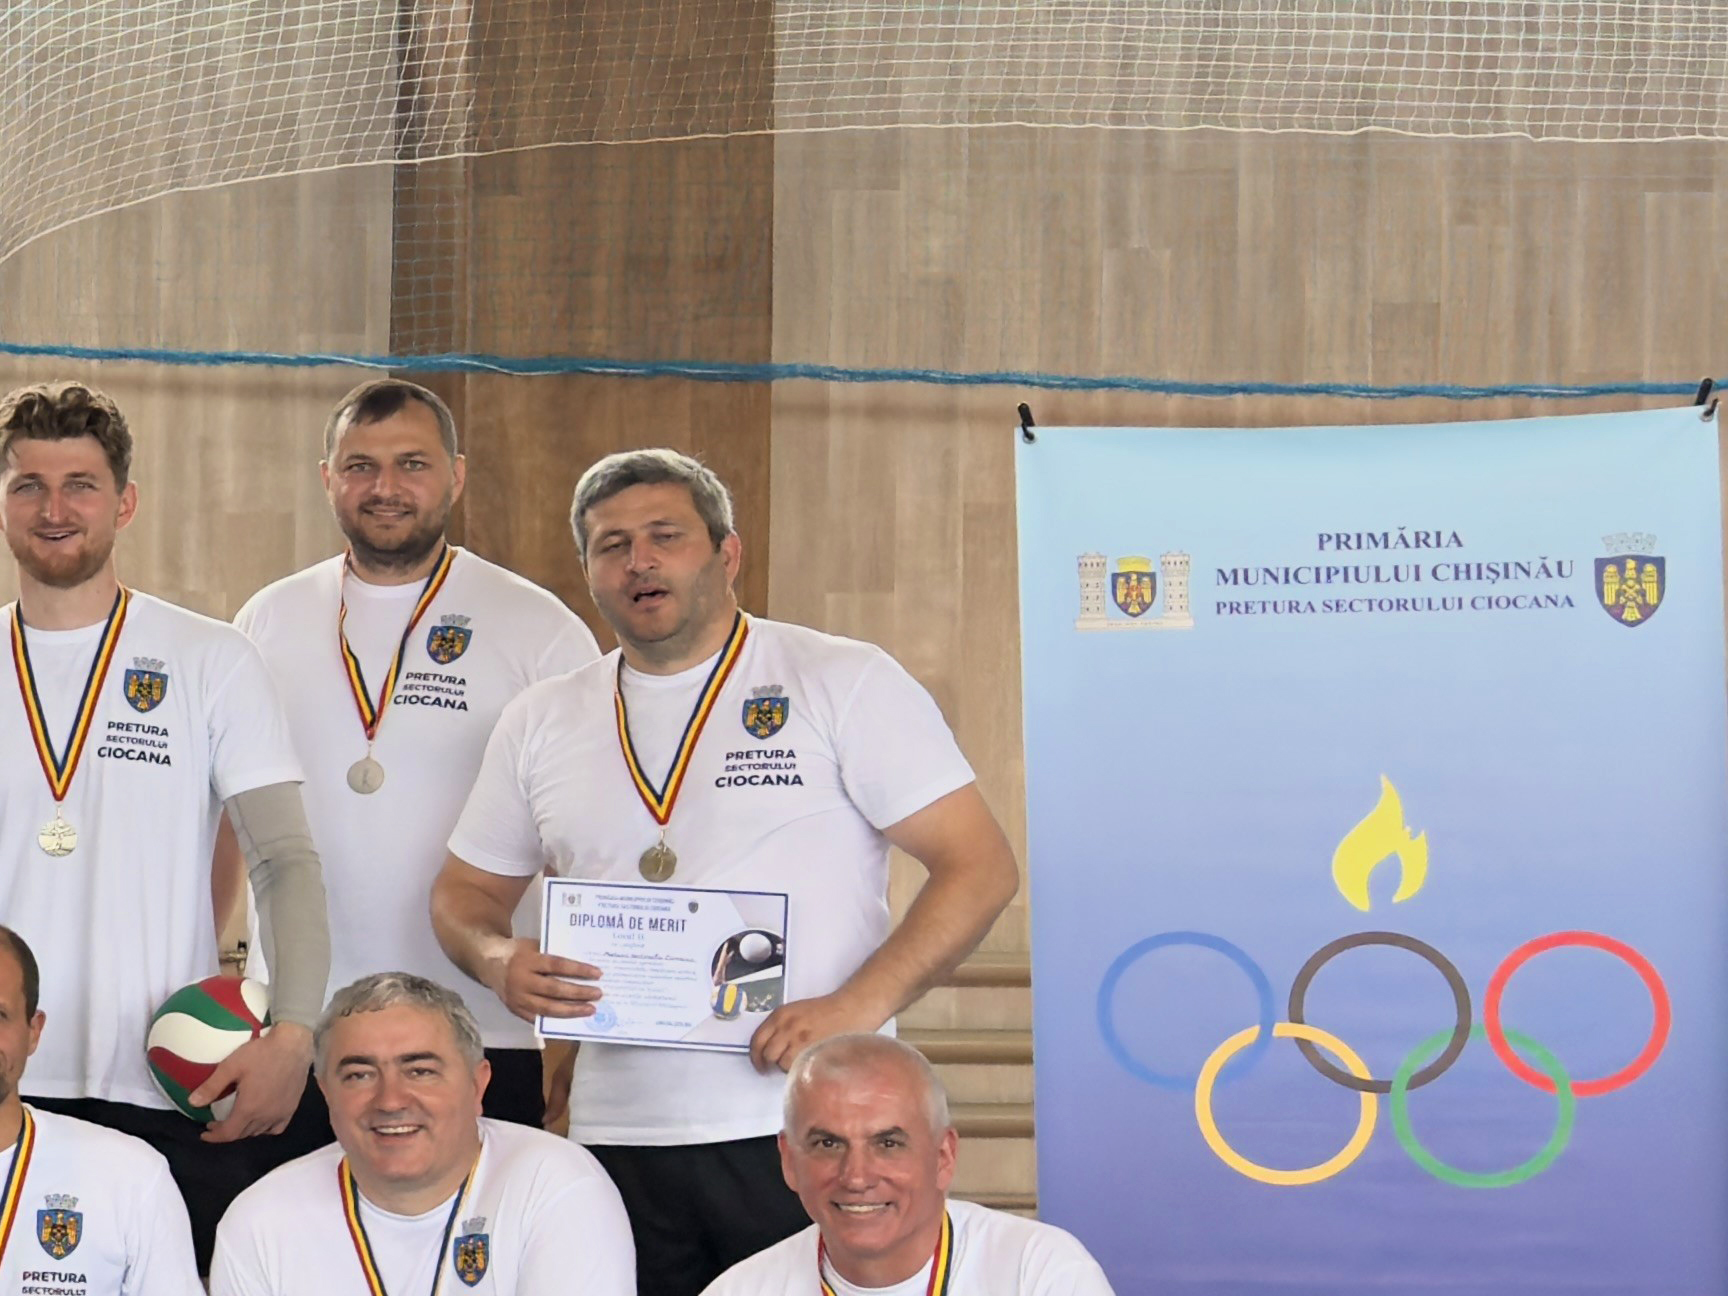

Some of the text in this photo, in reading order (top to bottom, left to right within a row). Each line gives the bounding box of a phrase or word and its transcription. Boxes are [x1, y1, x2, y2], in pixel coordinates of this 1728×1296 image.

[1317, 524, 1464, 552] PRIMĂRIA
[1215, 564, 1421, 587] MUNICIPIULUI
[1215, 594, 1575, 615] PRETURA SECTORULUI CIOCANA
[406, 672, 467, 686] PRETURA
[403, 683, 465, 696] SECTORULUI
[393, 694, 468, 712] CIOCANA
[107, 721, 169, 737] PRETURA
[106, 734, 168, 749] SECTORULUI
[97, 746, 172, 766] CIOCANA
[725, 749, 797, 761] PRETURA
[724, 763, 796, 772] SECTORULUI
[714, 774, 804, 788] CIOCANA
[569, 912, 687, 933] DIPLOMĂ DE MERIT
[22, 1271, 87, 1283] PRETURA
